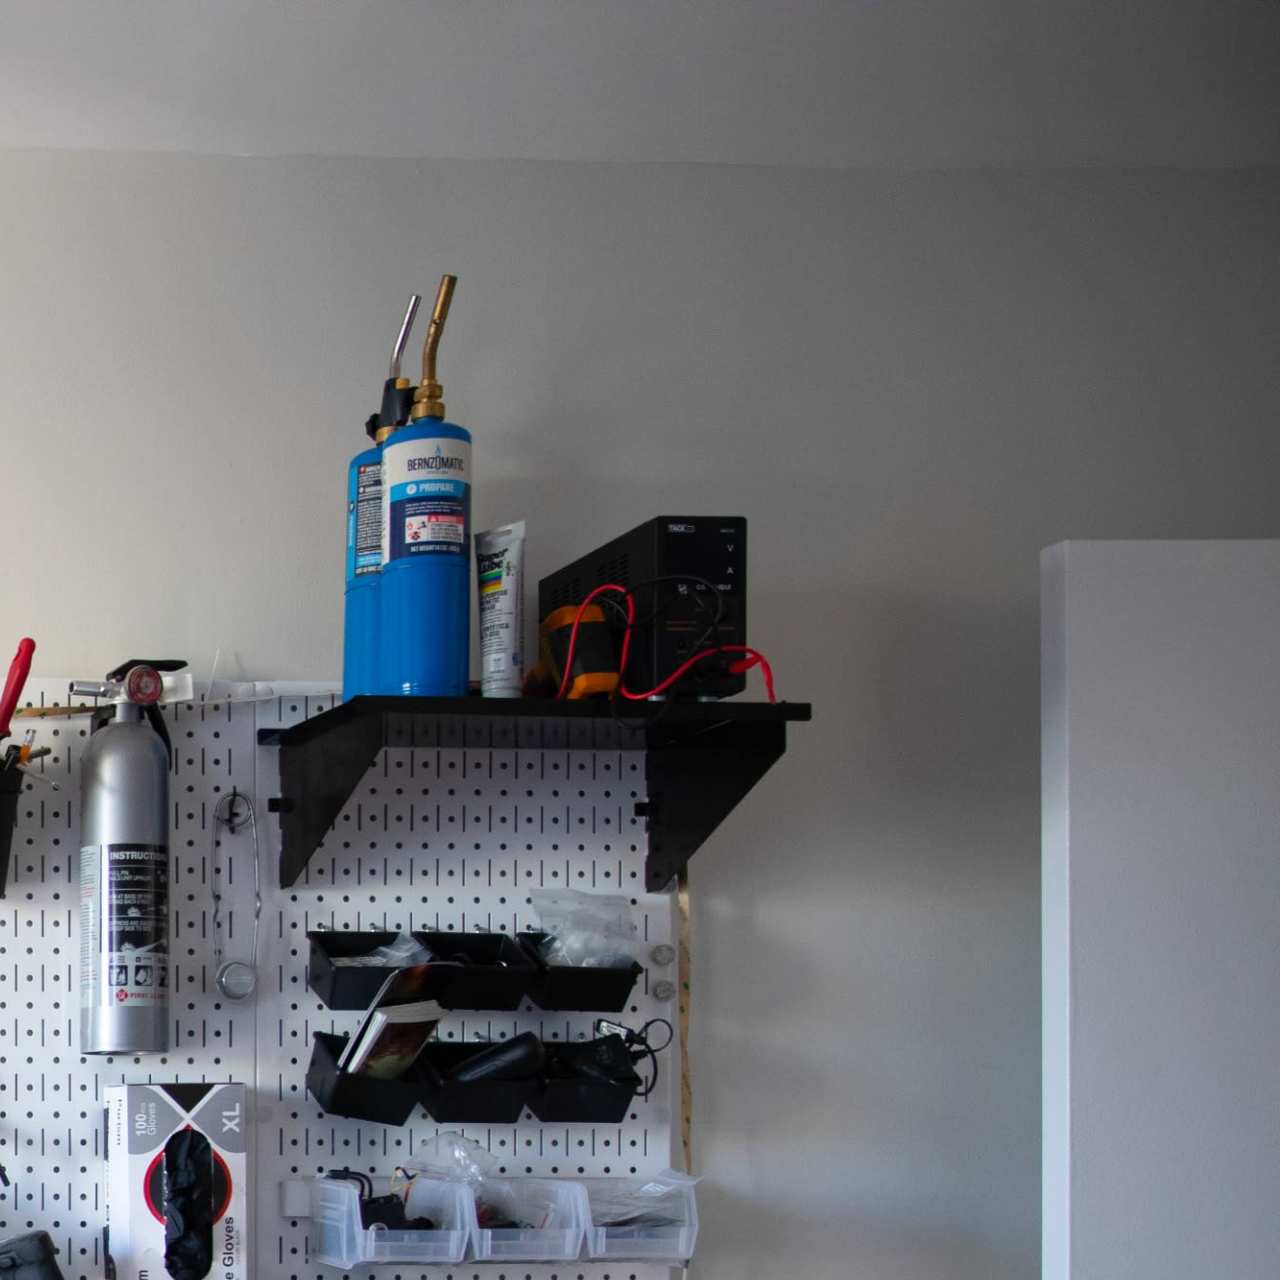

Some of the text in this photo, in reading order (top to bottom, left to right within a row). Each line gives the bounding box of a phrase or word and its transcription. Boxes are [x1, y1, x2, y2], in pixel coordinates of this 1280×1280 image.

[135, 1113, 148, 1136] 100
[147, 1102, 157, 1136] Gloves
[222, 1102, 240, 1133] XL
[222, 1216, 235, 1267] Gloves
